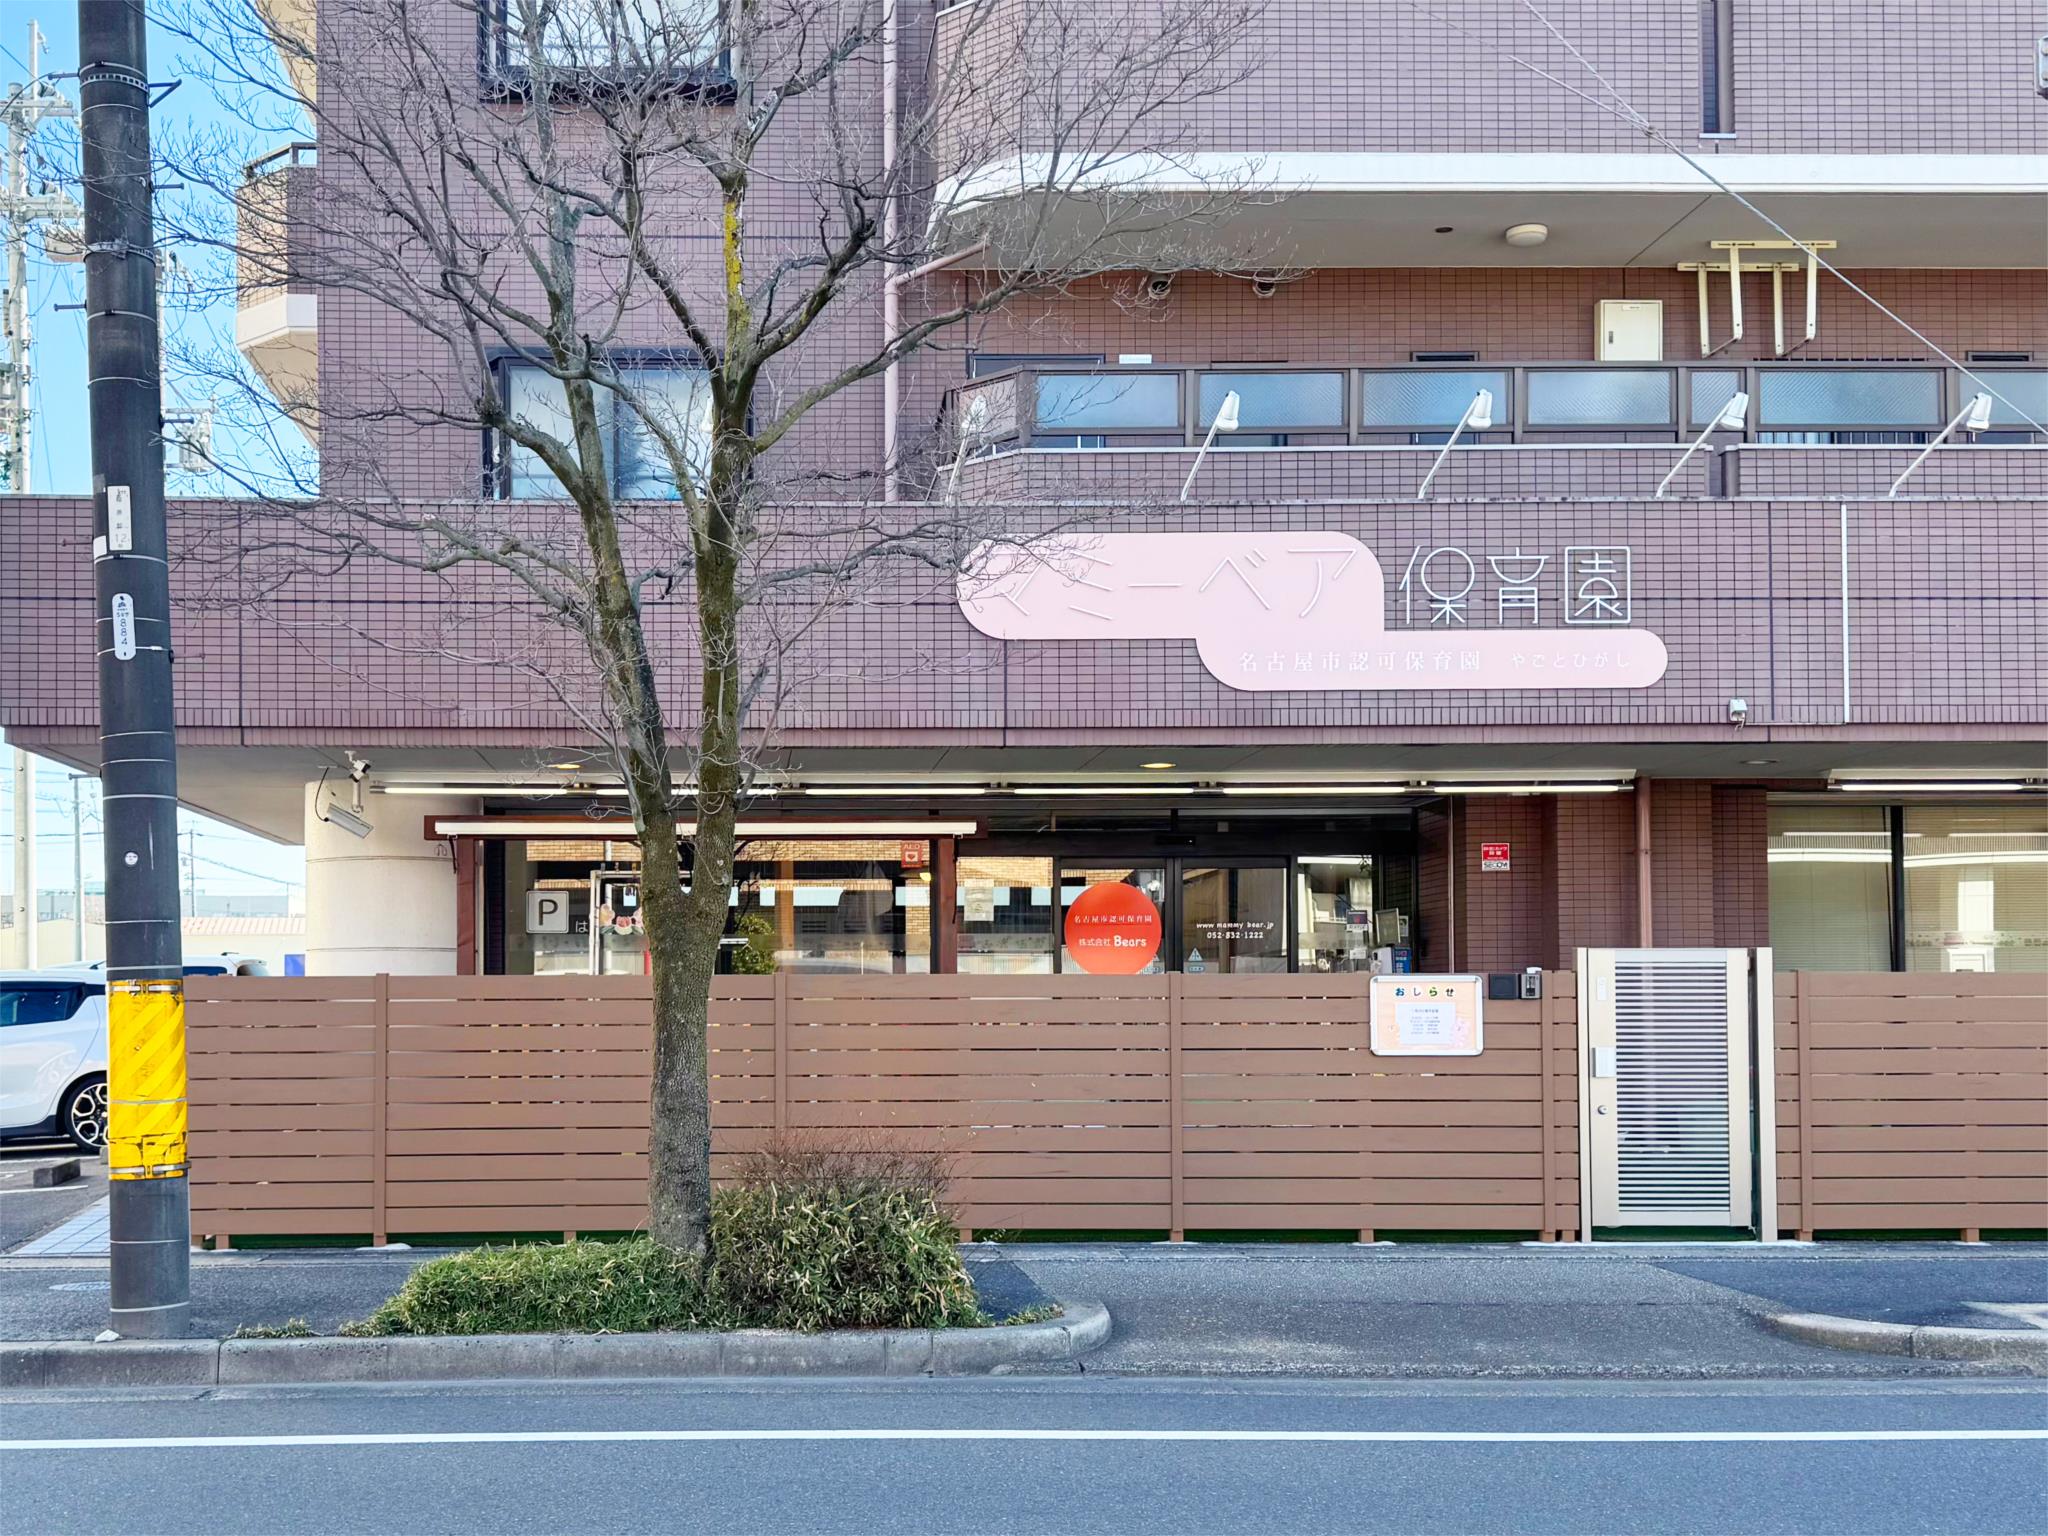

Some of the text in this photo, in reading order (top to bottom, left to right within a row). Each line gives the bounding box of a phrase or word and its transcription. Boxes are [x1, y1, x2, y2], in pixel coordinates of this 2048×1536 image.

[990, 544, 1631, 624] マミーベア 保育園
[1239, 650, 1631, 672] 名古屋市認可保育園 やごとひがし
[538, 898, 559, 926] P
[1079, 934, 1148, 948] 株式会社 Bears
[1395, 986, 1455, 997] おしらせ
